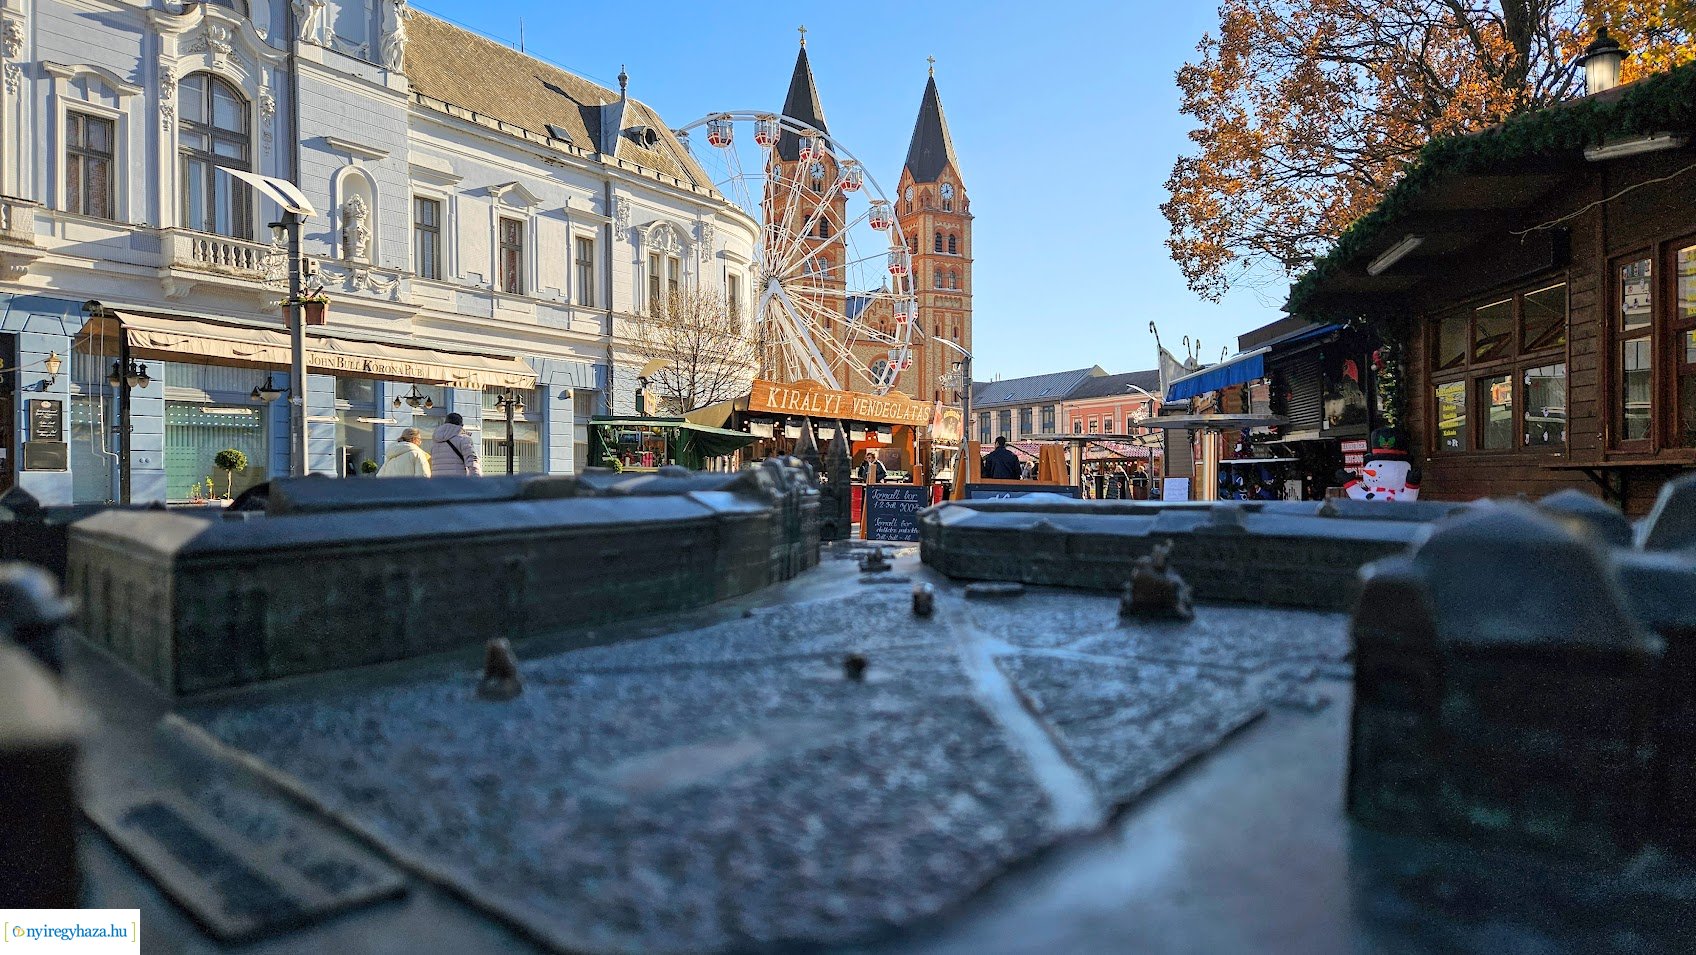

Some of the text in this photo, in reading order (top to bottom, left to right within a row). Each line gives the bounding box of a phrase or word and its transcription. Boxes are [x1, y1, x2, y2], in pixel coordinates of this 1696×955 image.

[309, 353, 424, 377] JOHN BULL KORONA PUB
[766, 387, 842, 414] KIRÁLYI
